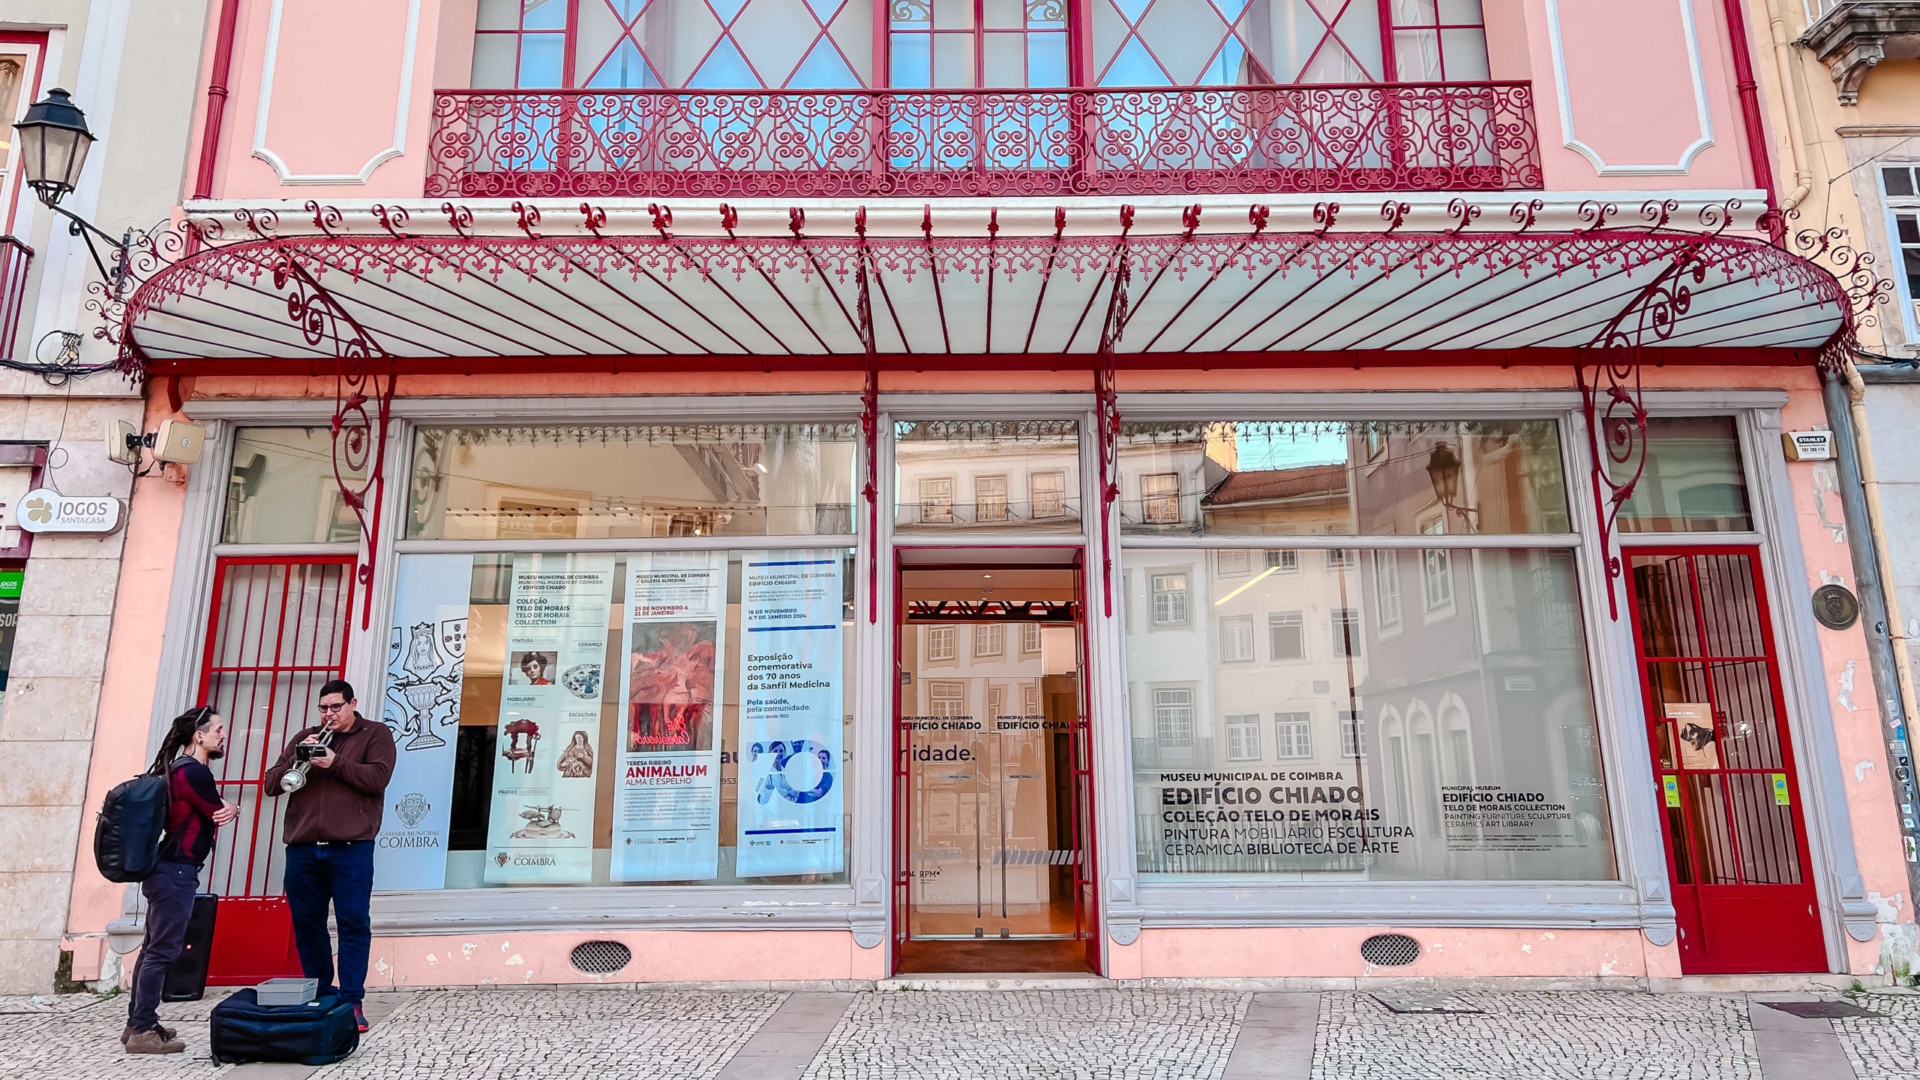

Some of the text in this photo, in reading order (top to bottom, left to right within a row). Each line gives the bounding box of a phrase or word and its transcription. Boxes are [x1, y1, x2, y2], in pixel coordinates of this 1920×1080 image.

[56, 502, 108, 520] JOGOS
[748, 653, 793, 662] Exposição
[748, 662, 812, 671] comemorativa
[790, 680, 830, 688] Medicina
[900, 720, 938, 730] IFÍCIO
[997, 719, 1039, 729] EDIFÍCIO
[626, 765, 707, 778] ANIMALIUM
[1161, 772, 1343, 781] MUSEU MUNICIPAL DE COIMBRA
[1162, 782, 1363, 805] EDIFÍCIO CHIADO
[1443, 790, 1544, 802] EDIFÍCIO CHIADO
[1163, 807, 1380, 826] COLEÇÃO TELO DE MORAIS
[1164, 824, 1414, 840] PINTURA MOBILIÁRIO ESCULTURA
[379, 837, 439, 848] COIMBRA
[1164, 842, 1400, 856] CERAMICA BIBLIOTECA DE ARTE
[514, 858, 556, 866] COIMBRA
